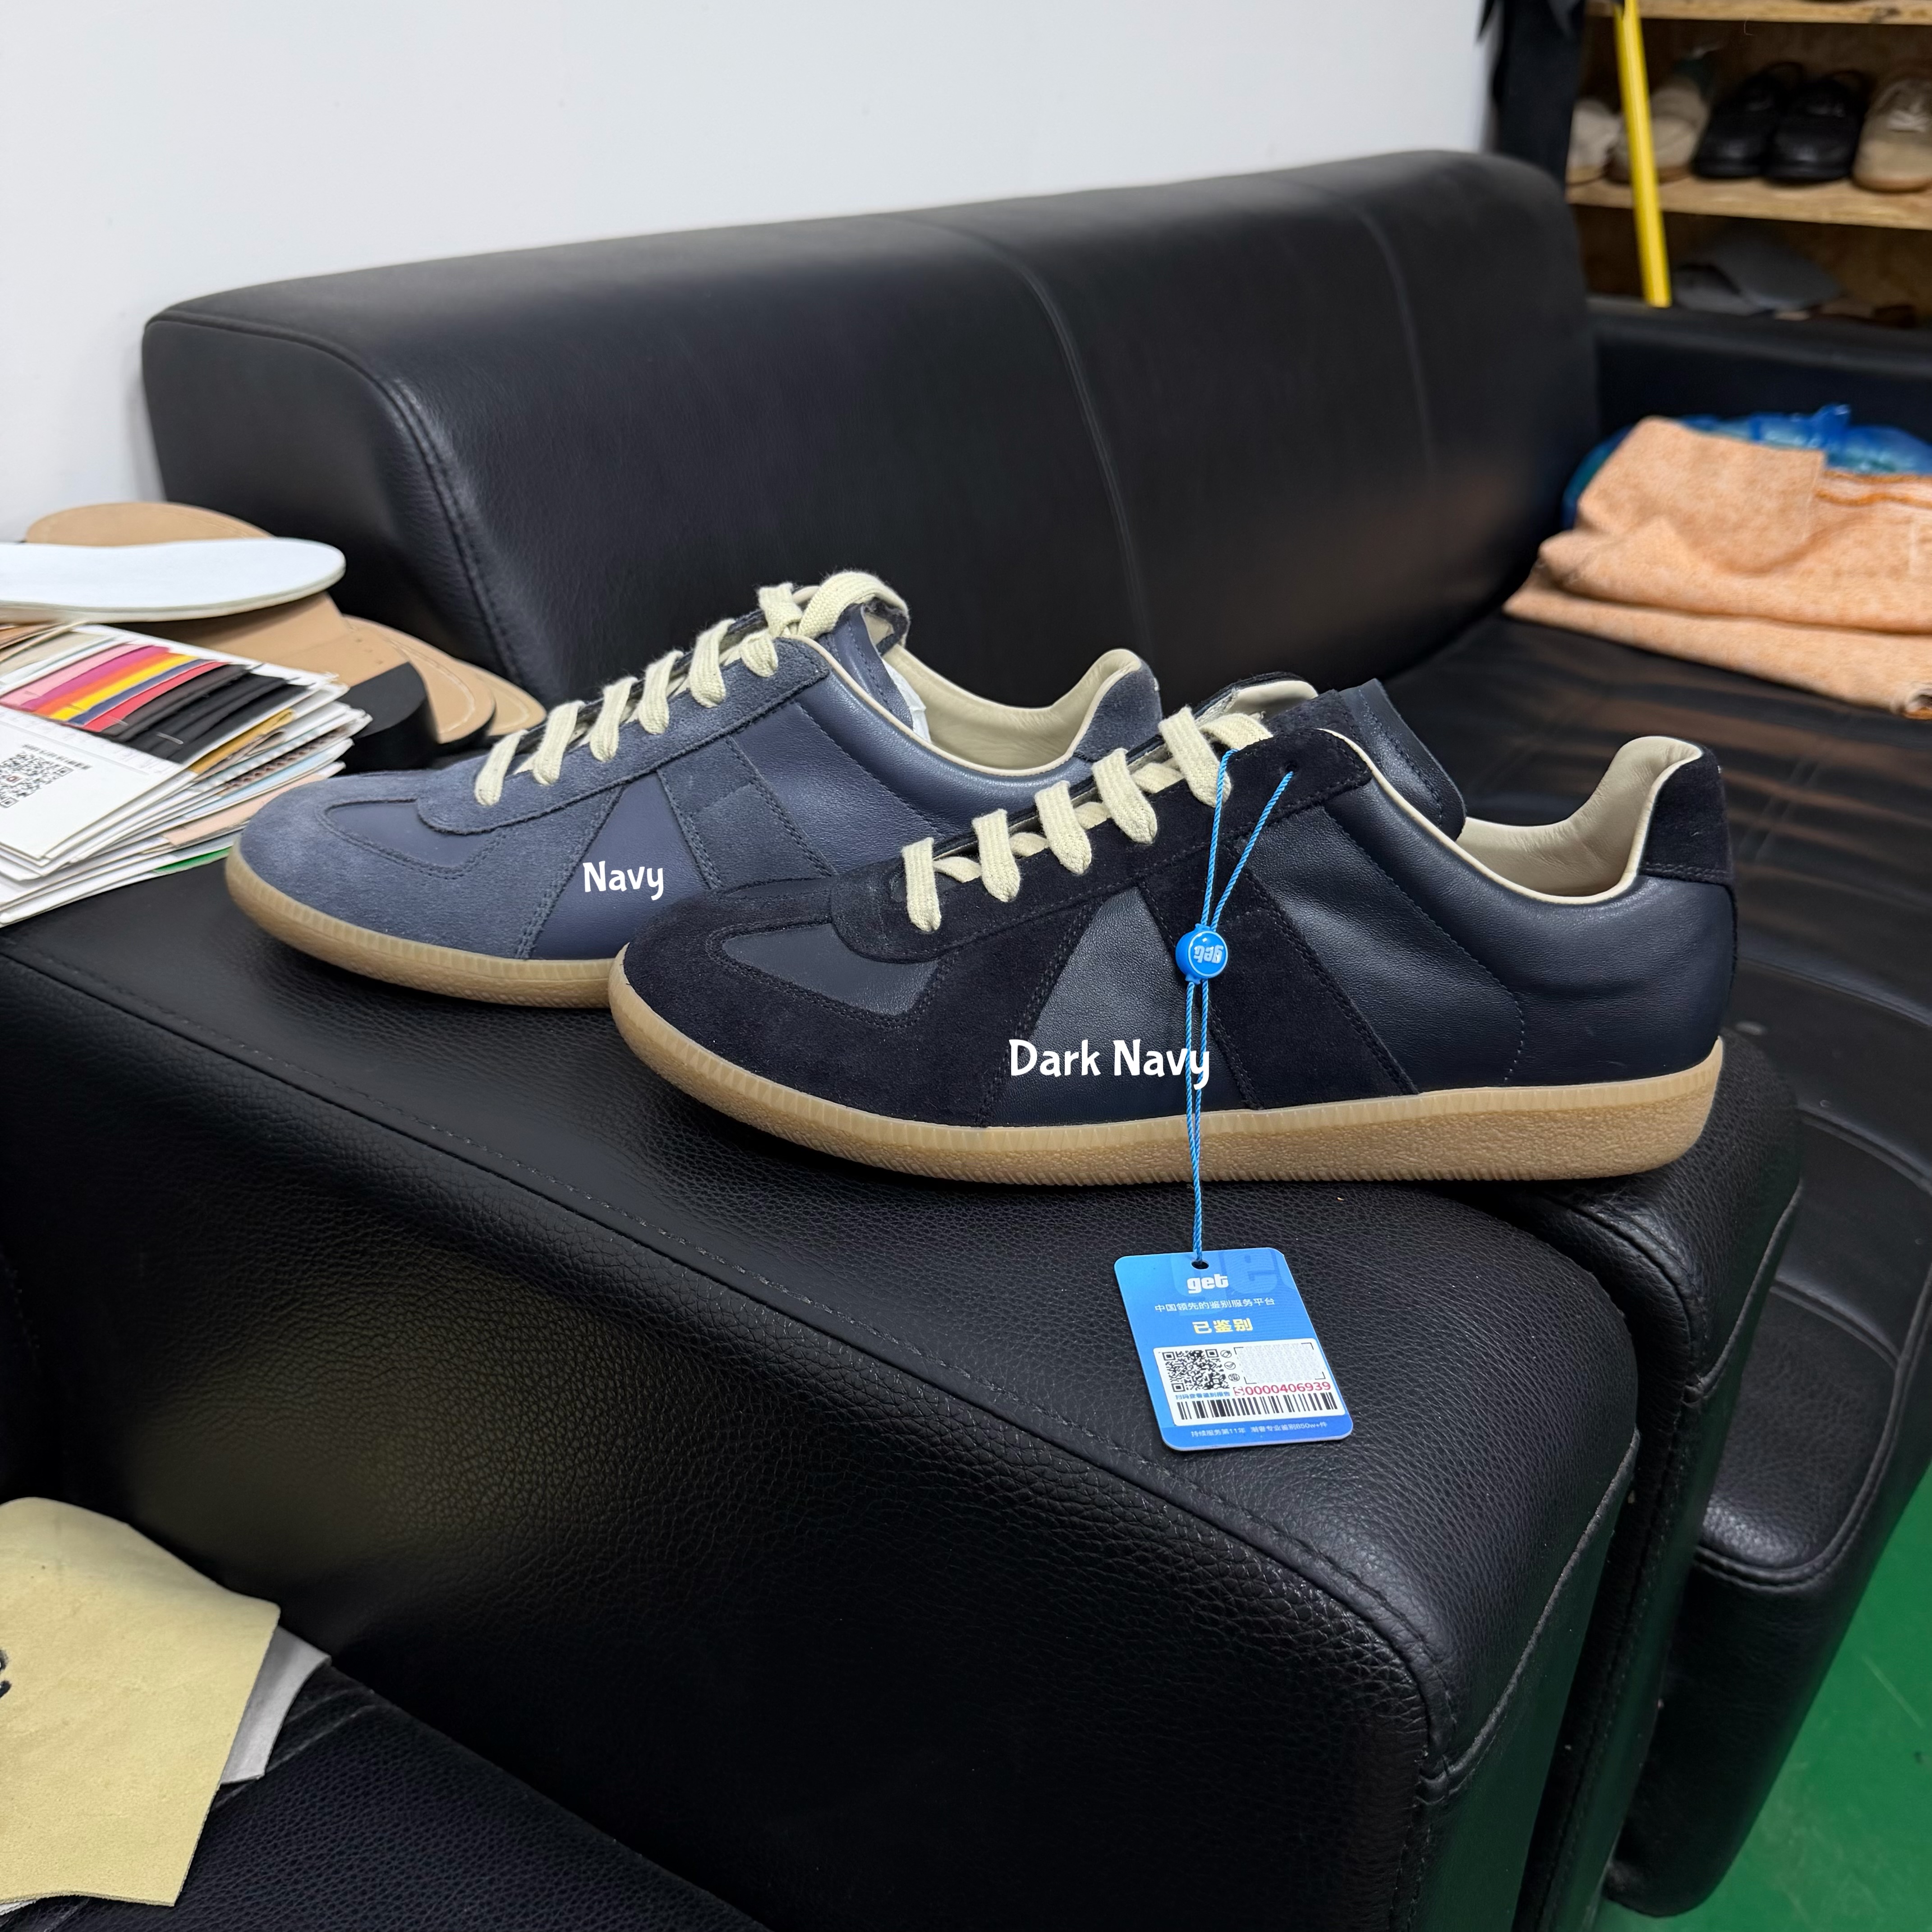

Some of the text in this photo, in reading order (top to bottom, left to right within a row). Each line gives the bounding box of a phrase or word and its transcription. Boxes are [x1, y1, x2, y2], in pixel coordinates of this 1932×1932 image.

[1193, 945, 1224, 964] get
[1187, 1274, 1229, 1294] get
[1155, 1297, 1275, 1312] 中国领先的鉴别服务平台
[1192, 1318, 1253, 1334] 已鉴别
